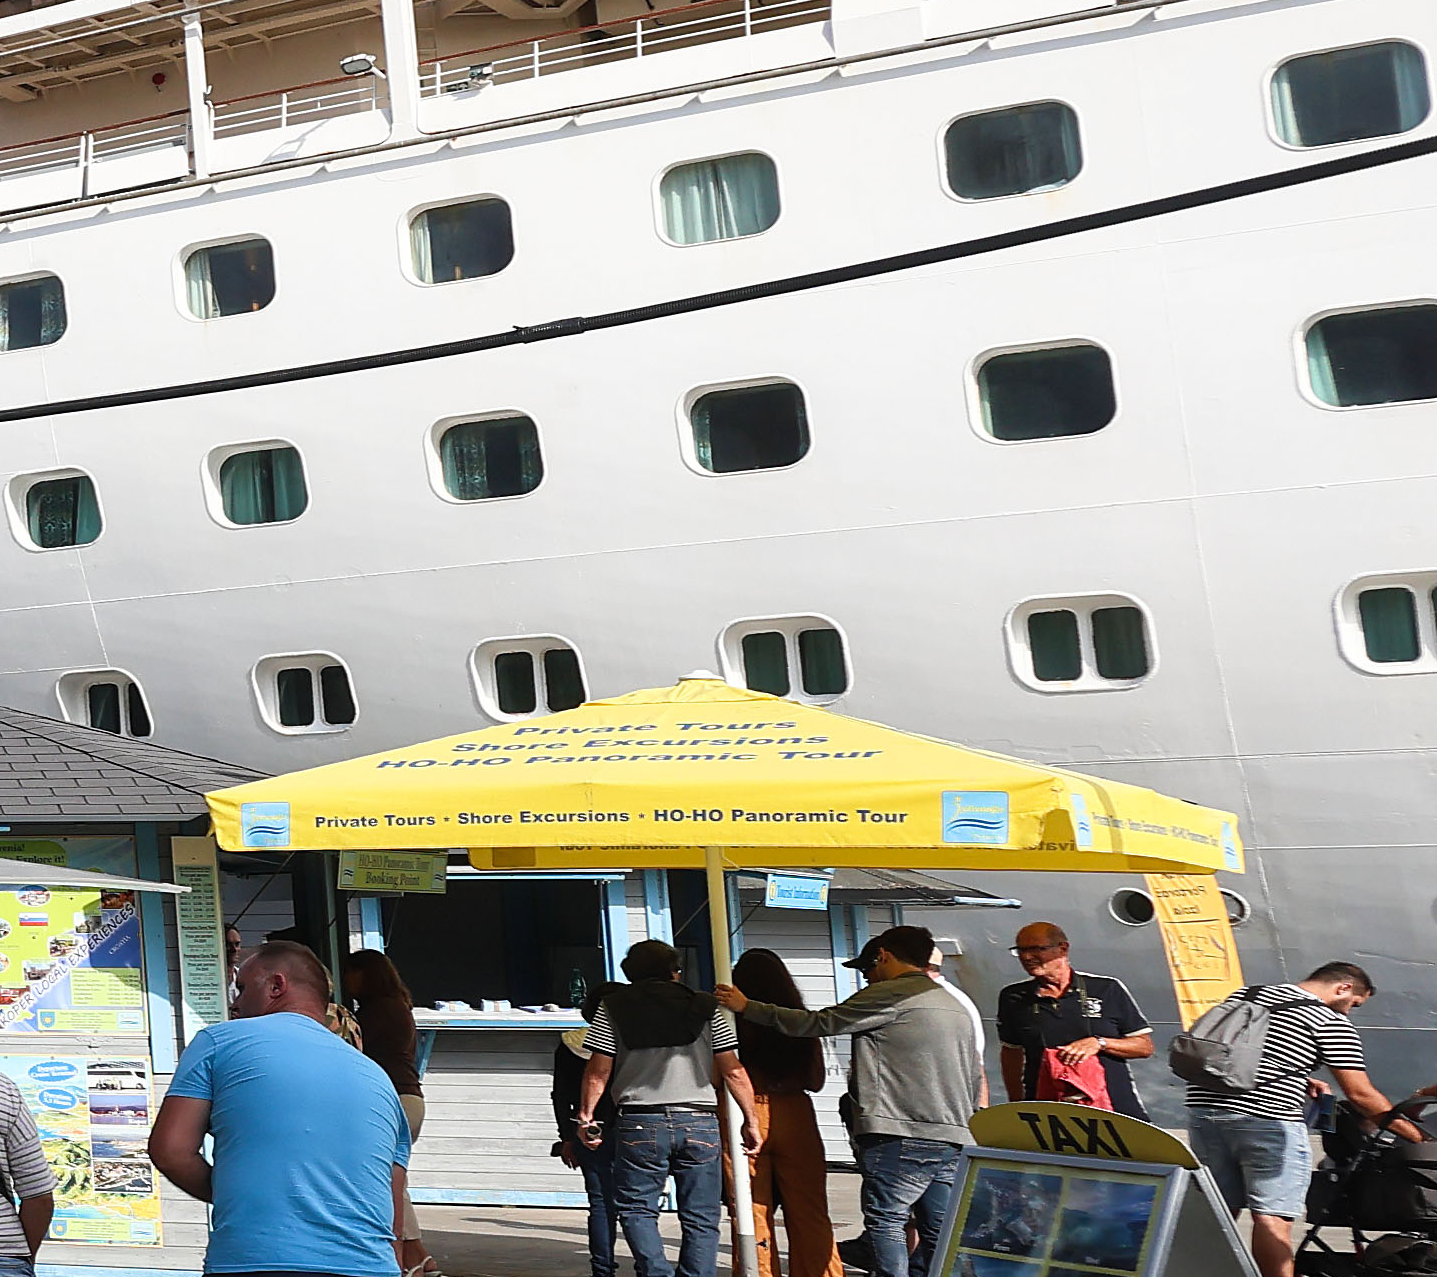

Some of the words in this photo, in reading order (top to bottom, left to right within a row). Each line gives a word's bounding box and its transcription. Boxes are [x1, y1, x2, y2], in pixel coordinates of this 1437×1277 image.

[514, 722, 658, 736] Private
[675, 721, 797, 731] Tours
[451, 741, 569, 752] Shore
[582, 735, 831, 749] Excursions
[377, 757, 512, 769] HO-HO
[525, 751, 758, 765] Panoramic
[778, 749, 883, 760] Tour
[314, 815, 378, 828] Private
[383, 813, 436, 827] Tours
[457, 812, 513, 825] Shore
[519, 810, 630, 824] Excursions
[653, 809, 724, 822] HO-HO
[731, 809, 849, 823] Panoramic
[856, 809, 908, 823] Tour
[49, 854, 66, 863] it!
[358, 854, 382, 868] HO-HO
[365, 873, 398, 887] Booking
[399, 874, 420, 886] Point
[0, 991, 35, 1029] KOPER
[37, 965, 68, 999] LOCAL
[68, 902, 135, 968] EXPERIENCES
[1017, 1111, 1133, 1158] TAXI
